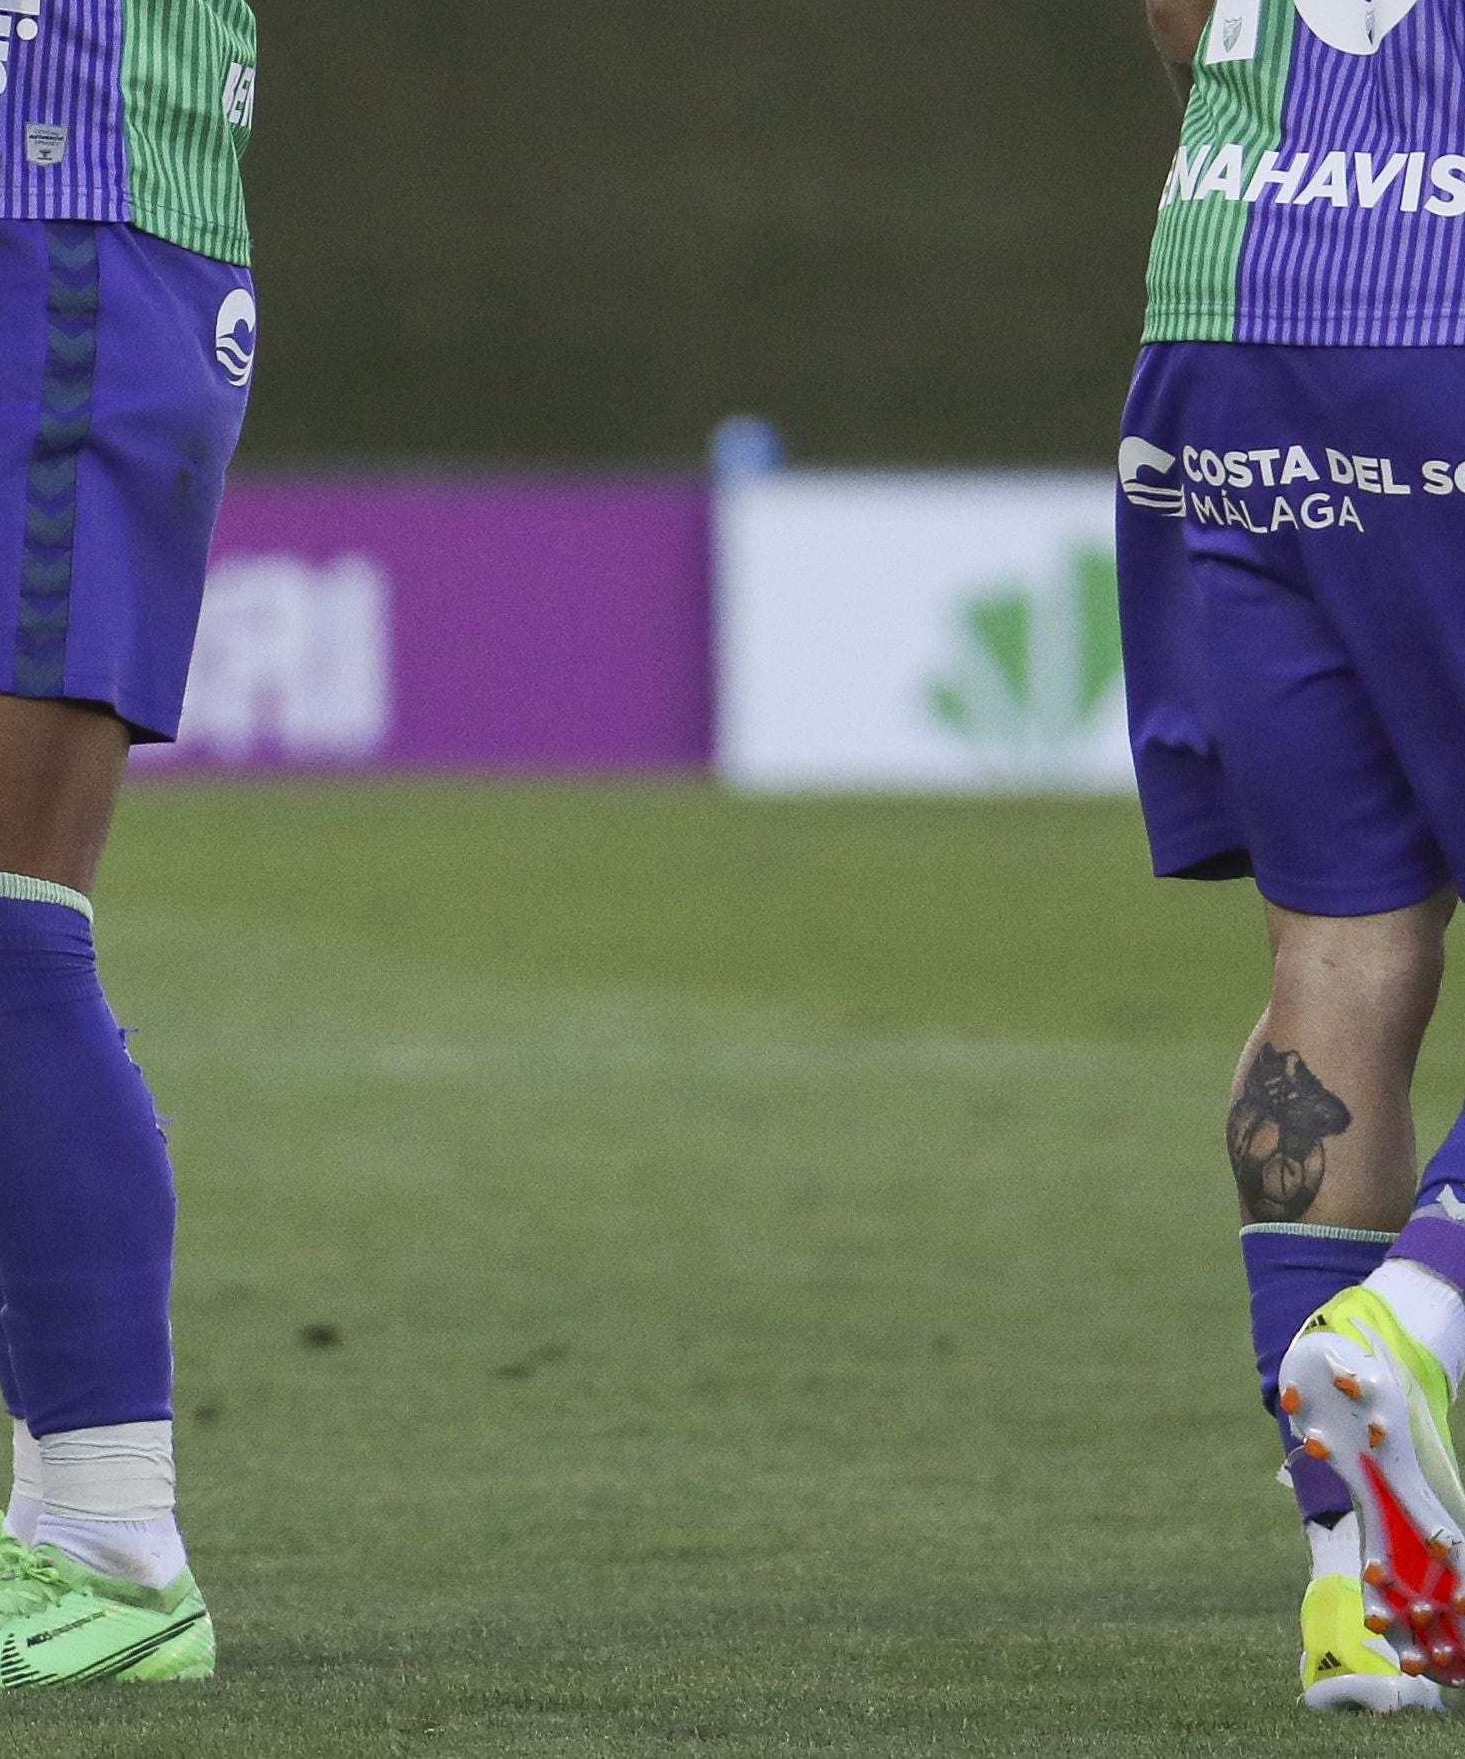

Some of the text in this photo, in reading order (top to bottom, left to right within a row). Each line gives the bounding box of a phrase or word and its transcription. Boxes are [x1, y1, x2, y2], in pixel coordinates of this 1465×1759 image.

[1182, 444, 1320, 488] COSTA
[1325, 447, 1411, 495] DEL
[1190, 489, 1365, 534] MÁLAGA
